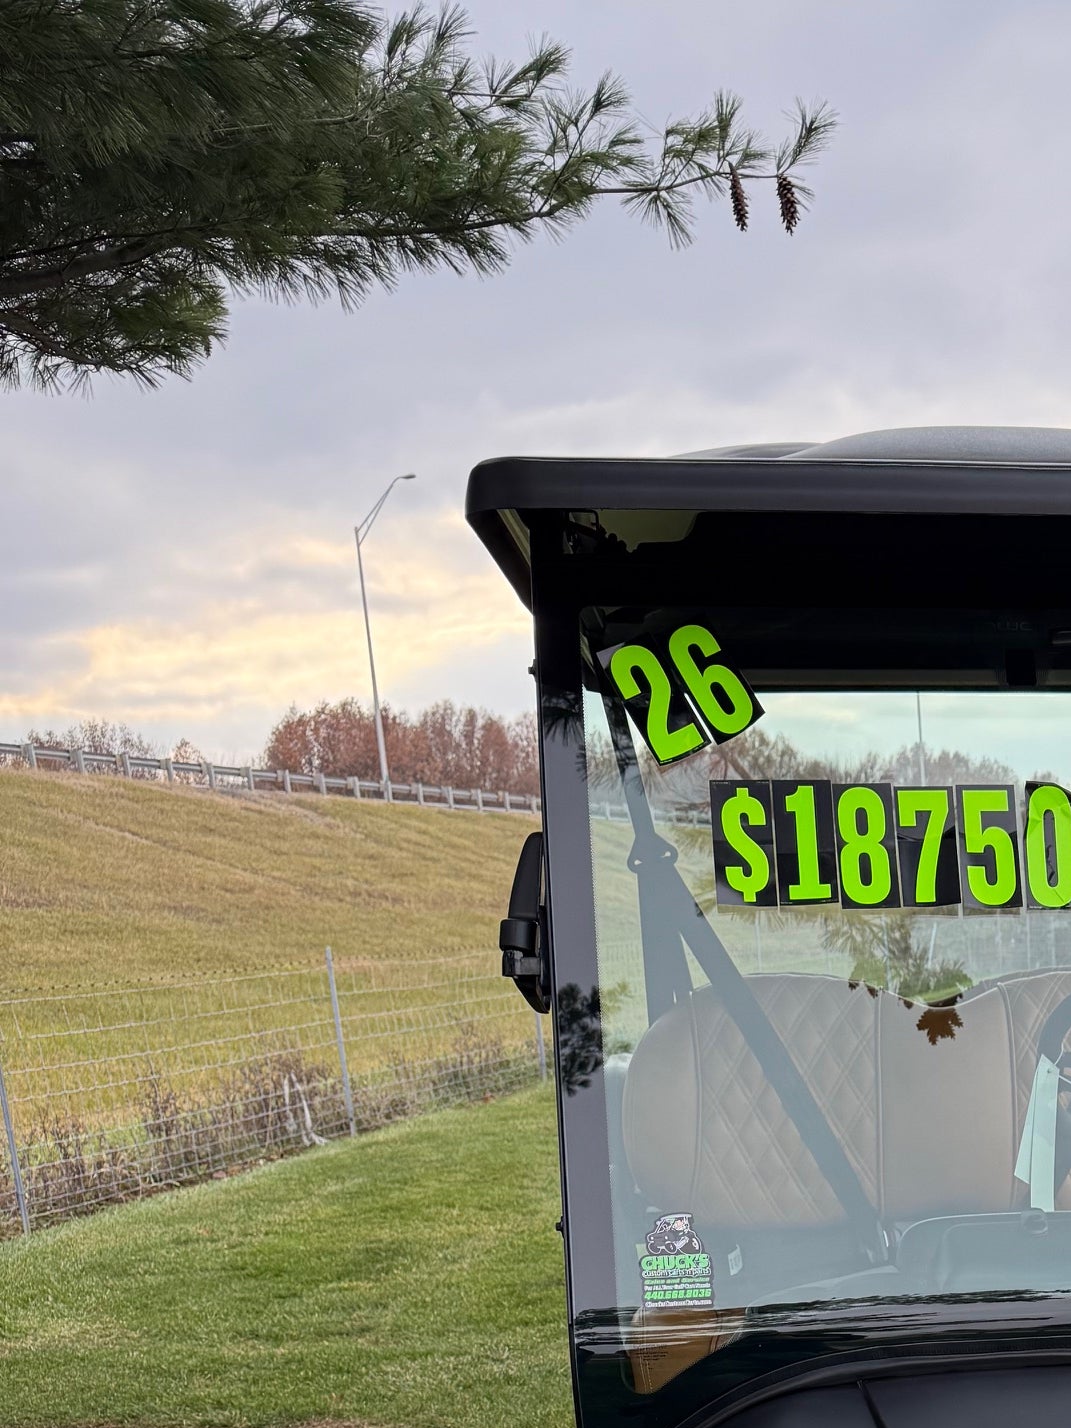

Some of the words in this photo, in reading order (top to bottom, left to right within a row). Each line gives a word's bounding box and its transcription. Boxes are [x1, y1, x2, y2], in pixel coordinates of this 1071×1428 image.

[610, 624, 753, 763] 26
[641, 1254, 709, 1270] CHUCK'S
[644, 1290, 711, 1299] 440.668.8036
